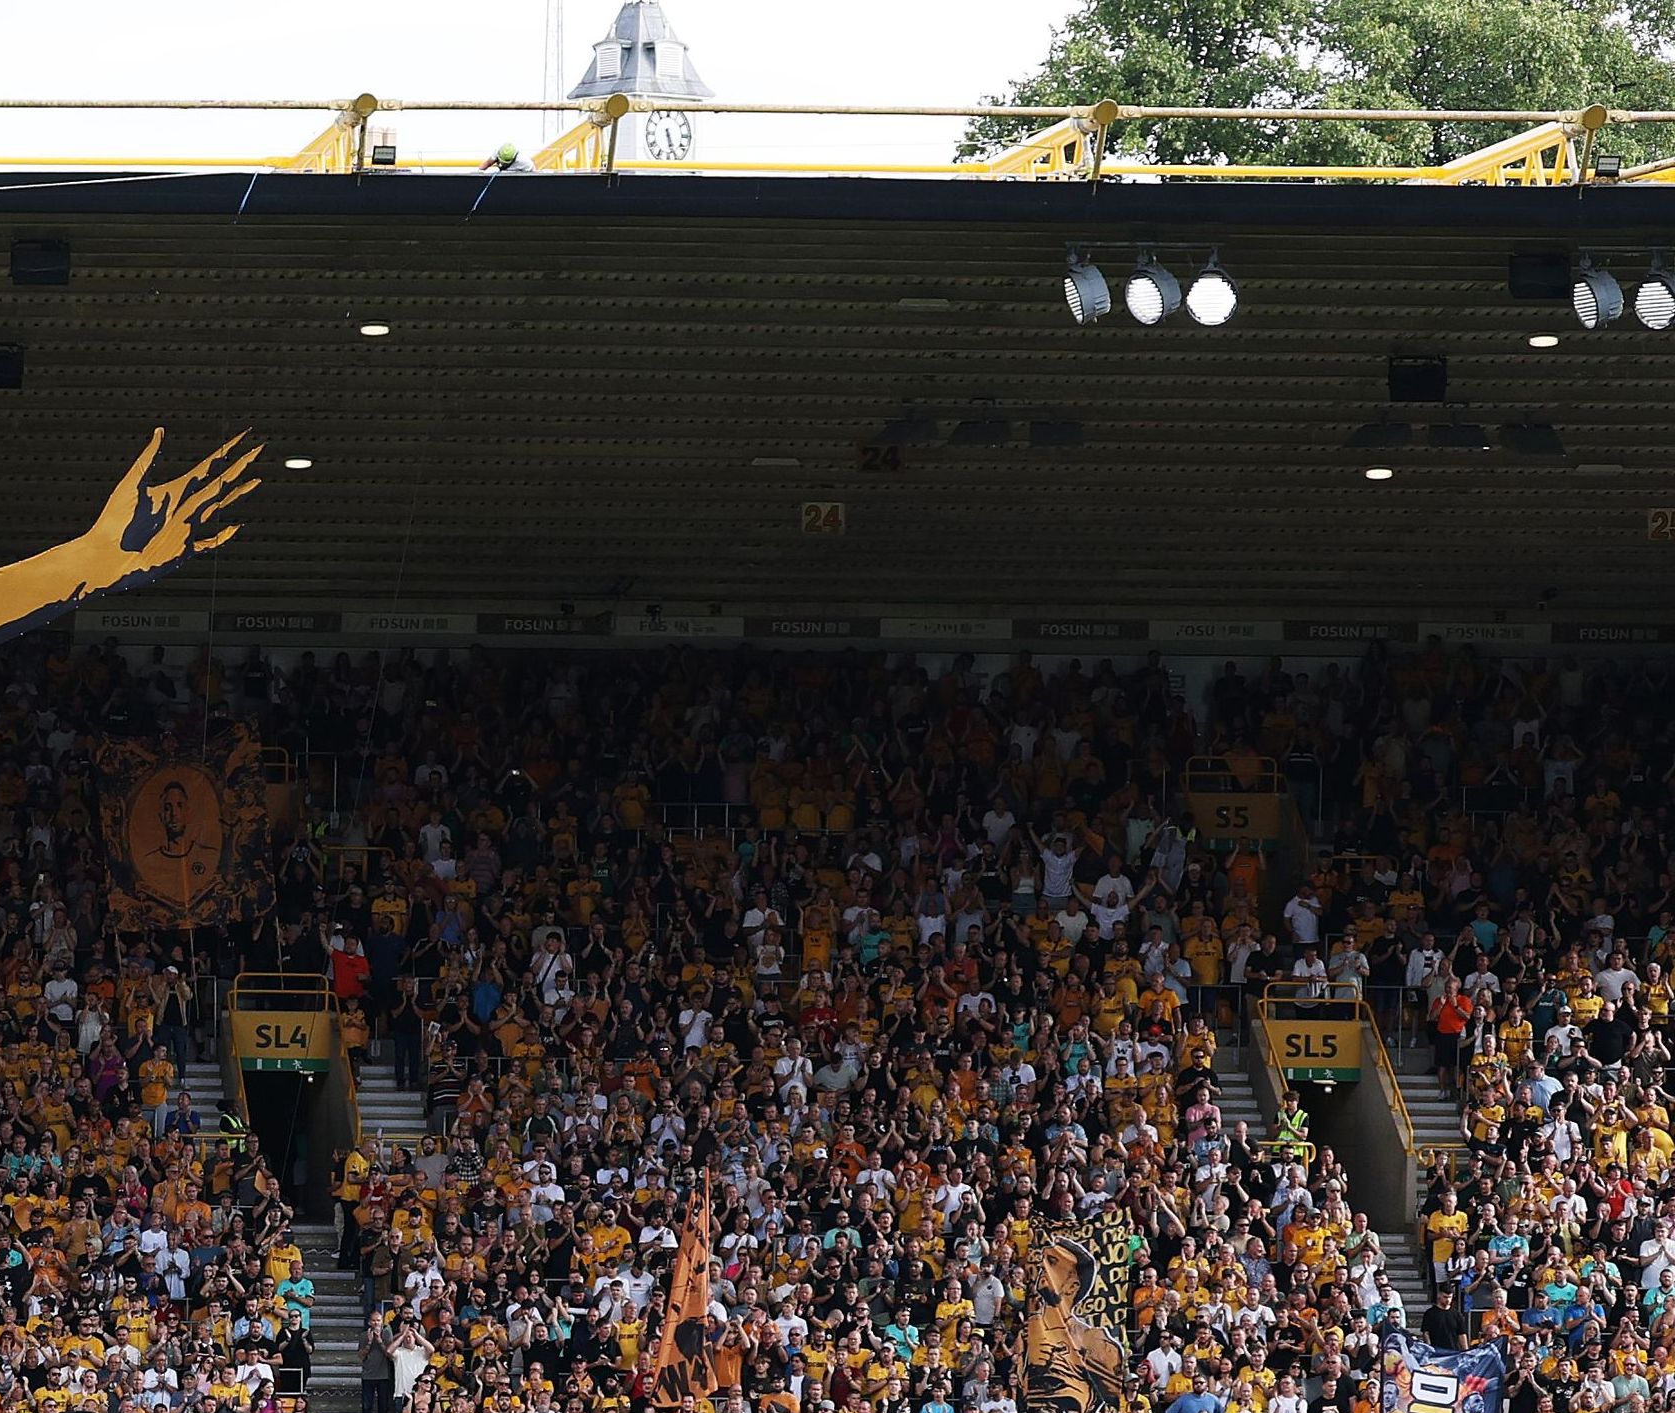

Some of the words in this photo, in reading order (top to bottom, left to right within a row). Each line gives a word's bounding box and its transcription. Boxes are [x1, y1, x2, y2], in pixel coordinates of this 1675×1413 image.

[862, 447, 899, 470] 24
[805, 505, 842, 532] 24
[102, 616, 152, 628] FOSUN
[236, 616, 286, 629] FOSUN
[371, 618, 420, 631] FOSUN
[504, 619, 554, 632] FOSUN
[772, 622, 822, 634] FOSUN
[1040, 623, 1091, 636] FOSUN
[1309, 625, 1360, 638] FOSUN
[1579, 628, 1629, 641] FOSUN
[1216, 806, 1249, 829] S5
[256, 1024, 307, 1048] SL4
[1285, 1034, 1337, 1058] SL5
